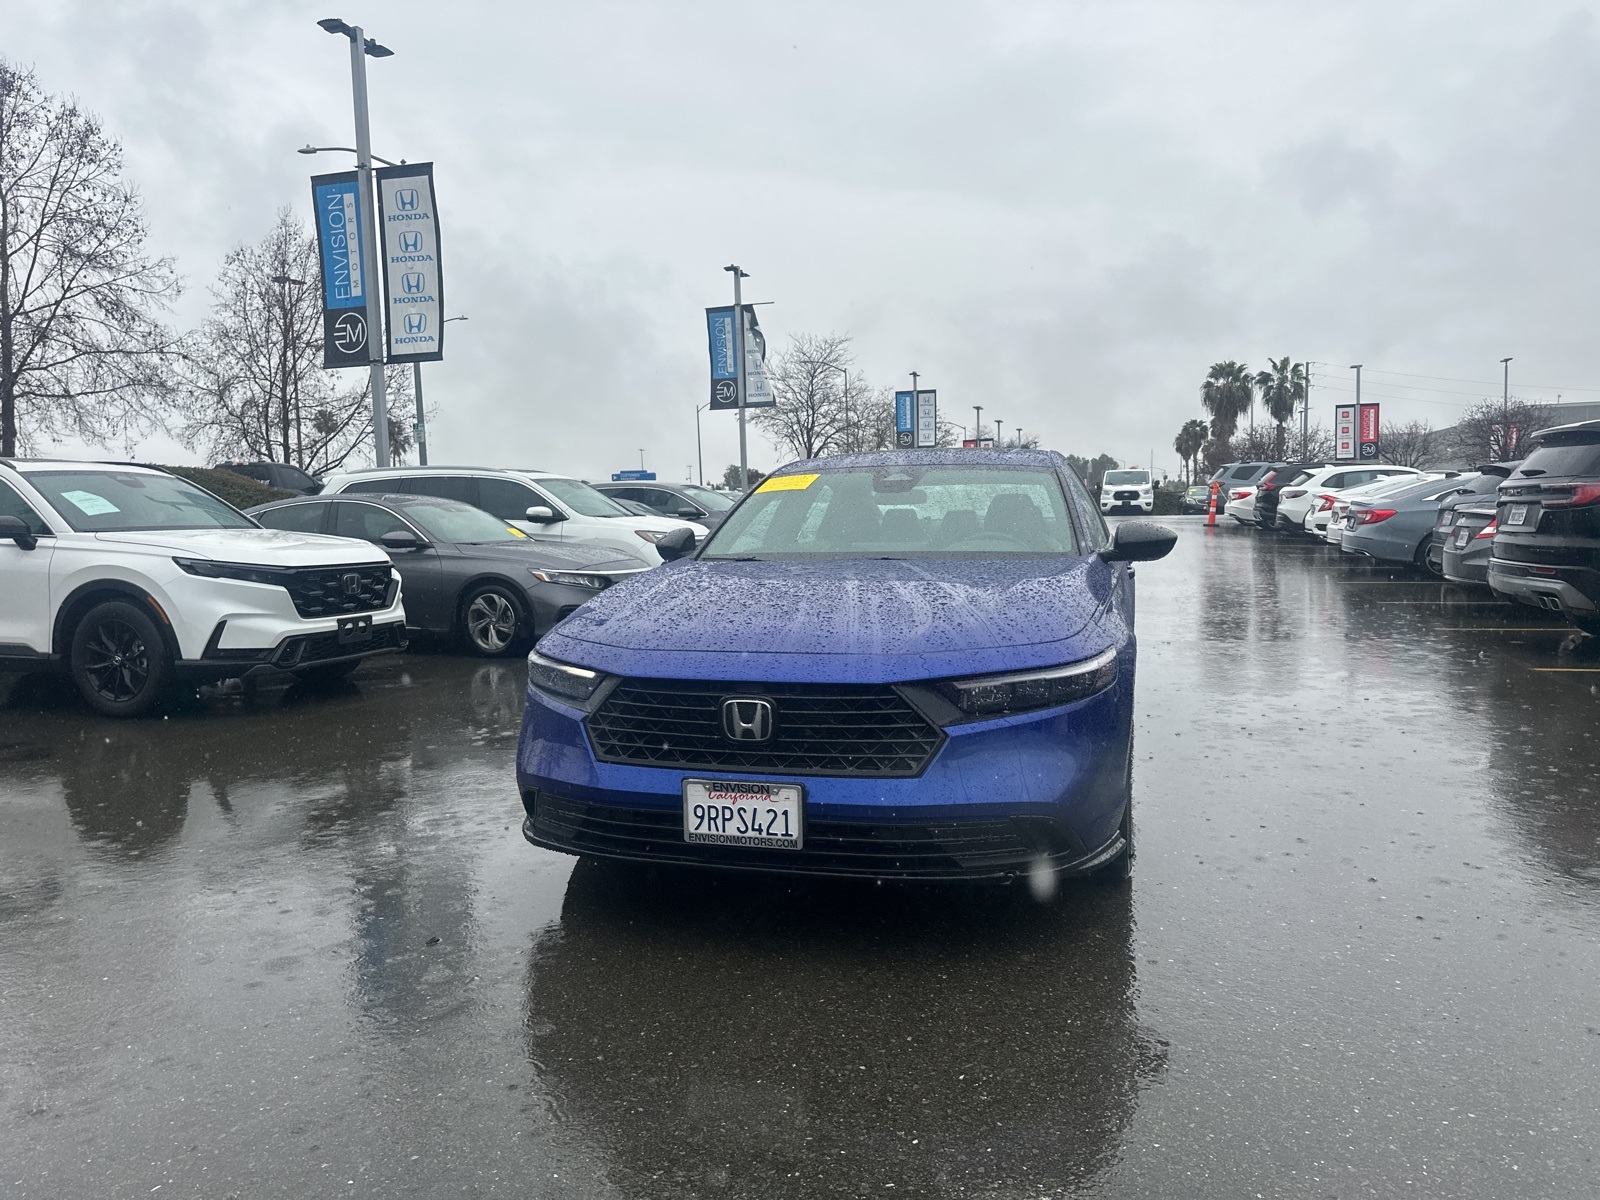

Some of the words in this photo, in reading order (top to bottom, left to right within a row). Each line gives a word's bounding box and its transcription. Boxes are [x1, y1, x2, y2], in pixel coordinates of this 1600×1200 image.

[388, 212, 430, 222] HONDA
[327, 194, 350, 299] ENVISION
[347, 202, 360, 288] MOTORS
[391, 254, 433, 263] HONDA
[393, 295, 435, 304] HONDA
[394, 335, 435, 344] HONDA
[715, 318, 727, 374] ENVISION
[712, 782, 770, 794] ENVISION
[708, 790, 779, 805] California
[693, 804, 793, 837] 9RPS421
[688, 833, 798, 849] ENVISIONMOTORS.COM
